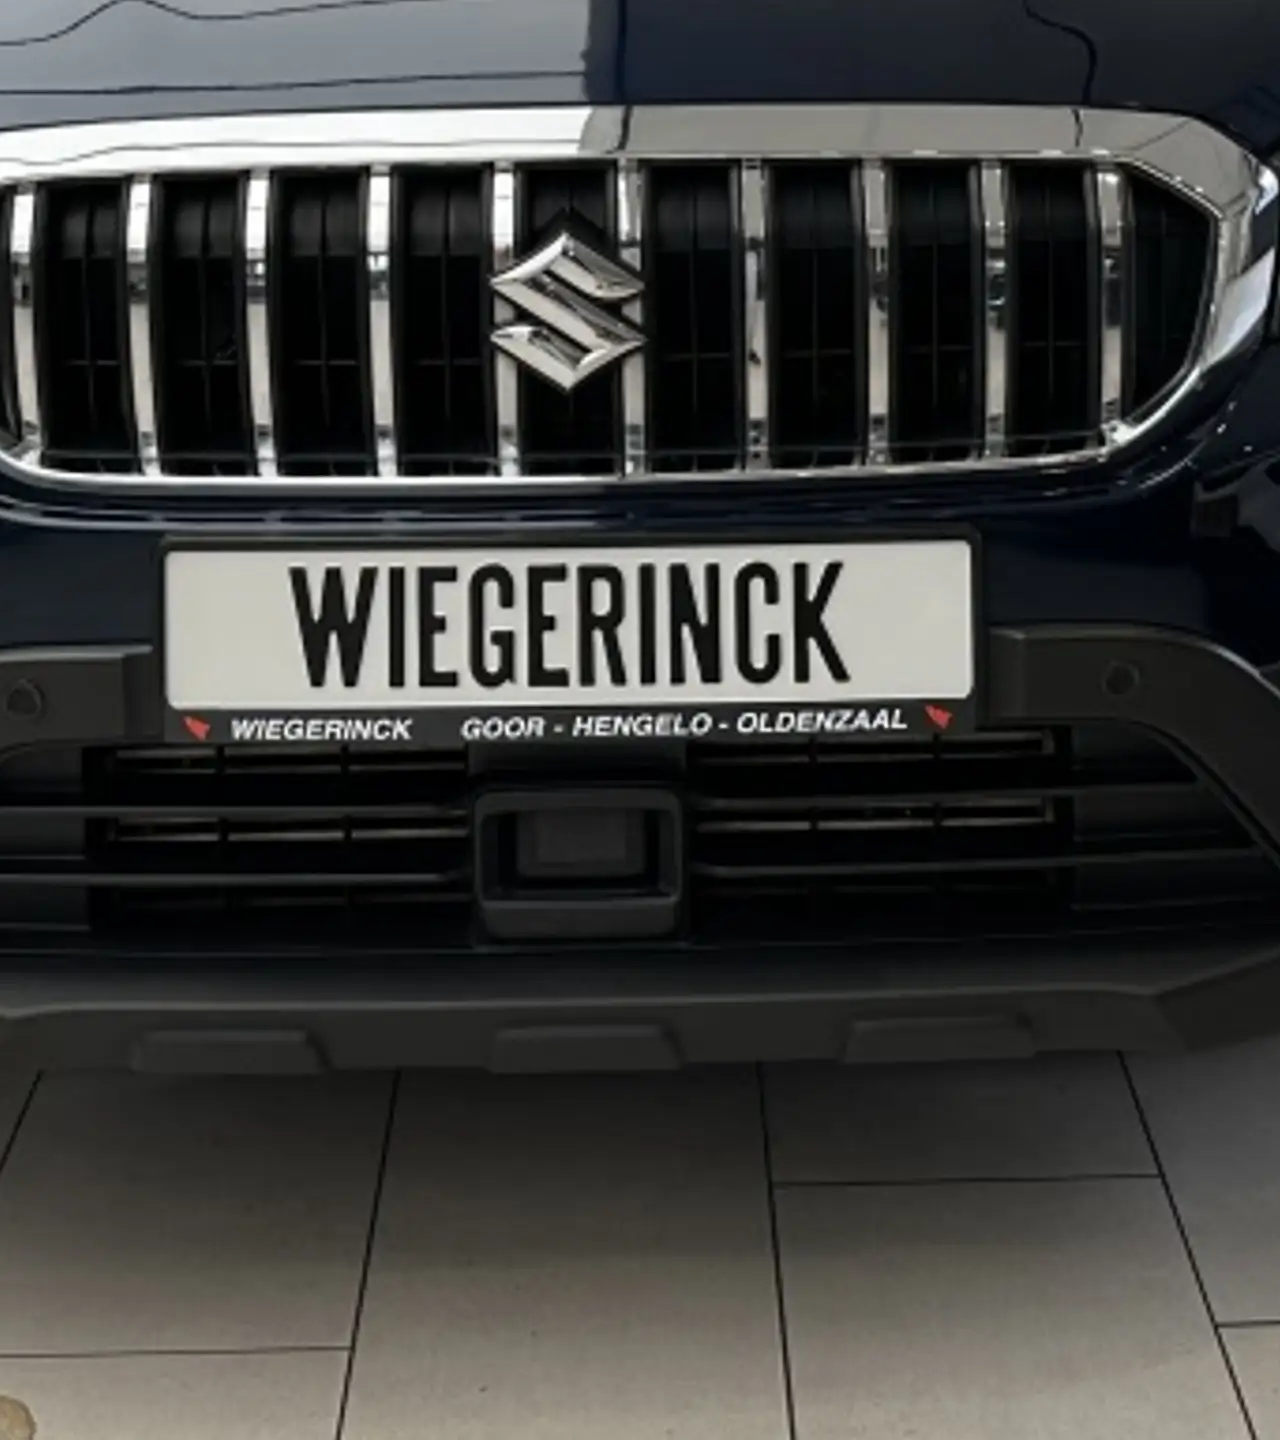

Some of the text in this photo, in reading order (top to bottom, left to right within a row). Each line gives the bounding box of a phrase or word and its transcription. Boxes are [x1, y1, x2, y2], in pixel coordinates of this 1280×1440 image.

[290, 562, 850, 688] WIEGERINCK
[231, 717, 413, 741] WIEGERINCK
[460, 716, 546, 741] GOOR
[572, 712, 713, 737] HENGELO
[736, 708, 908, 734] OLDENZAAL
